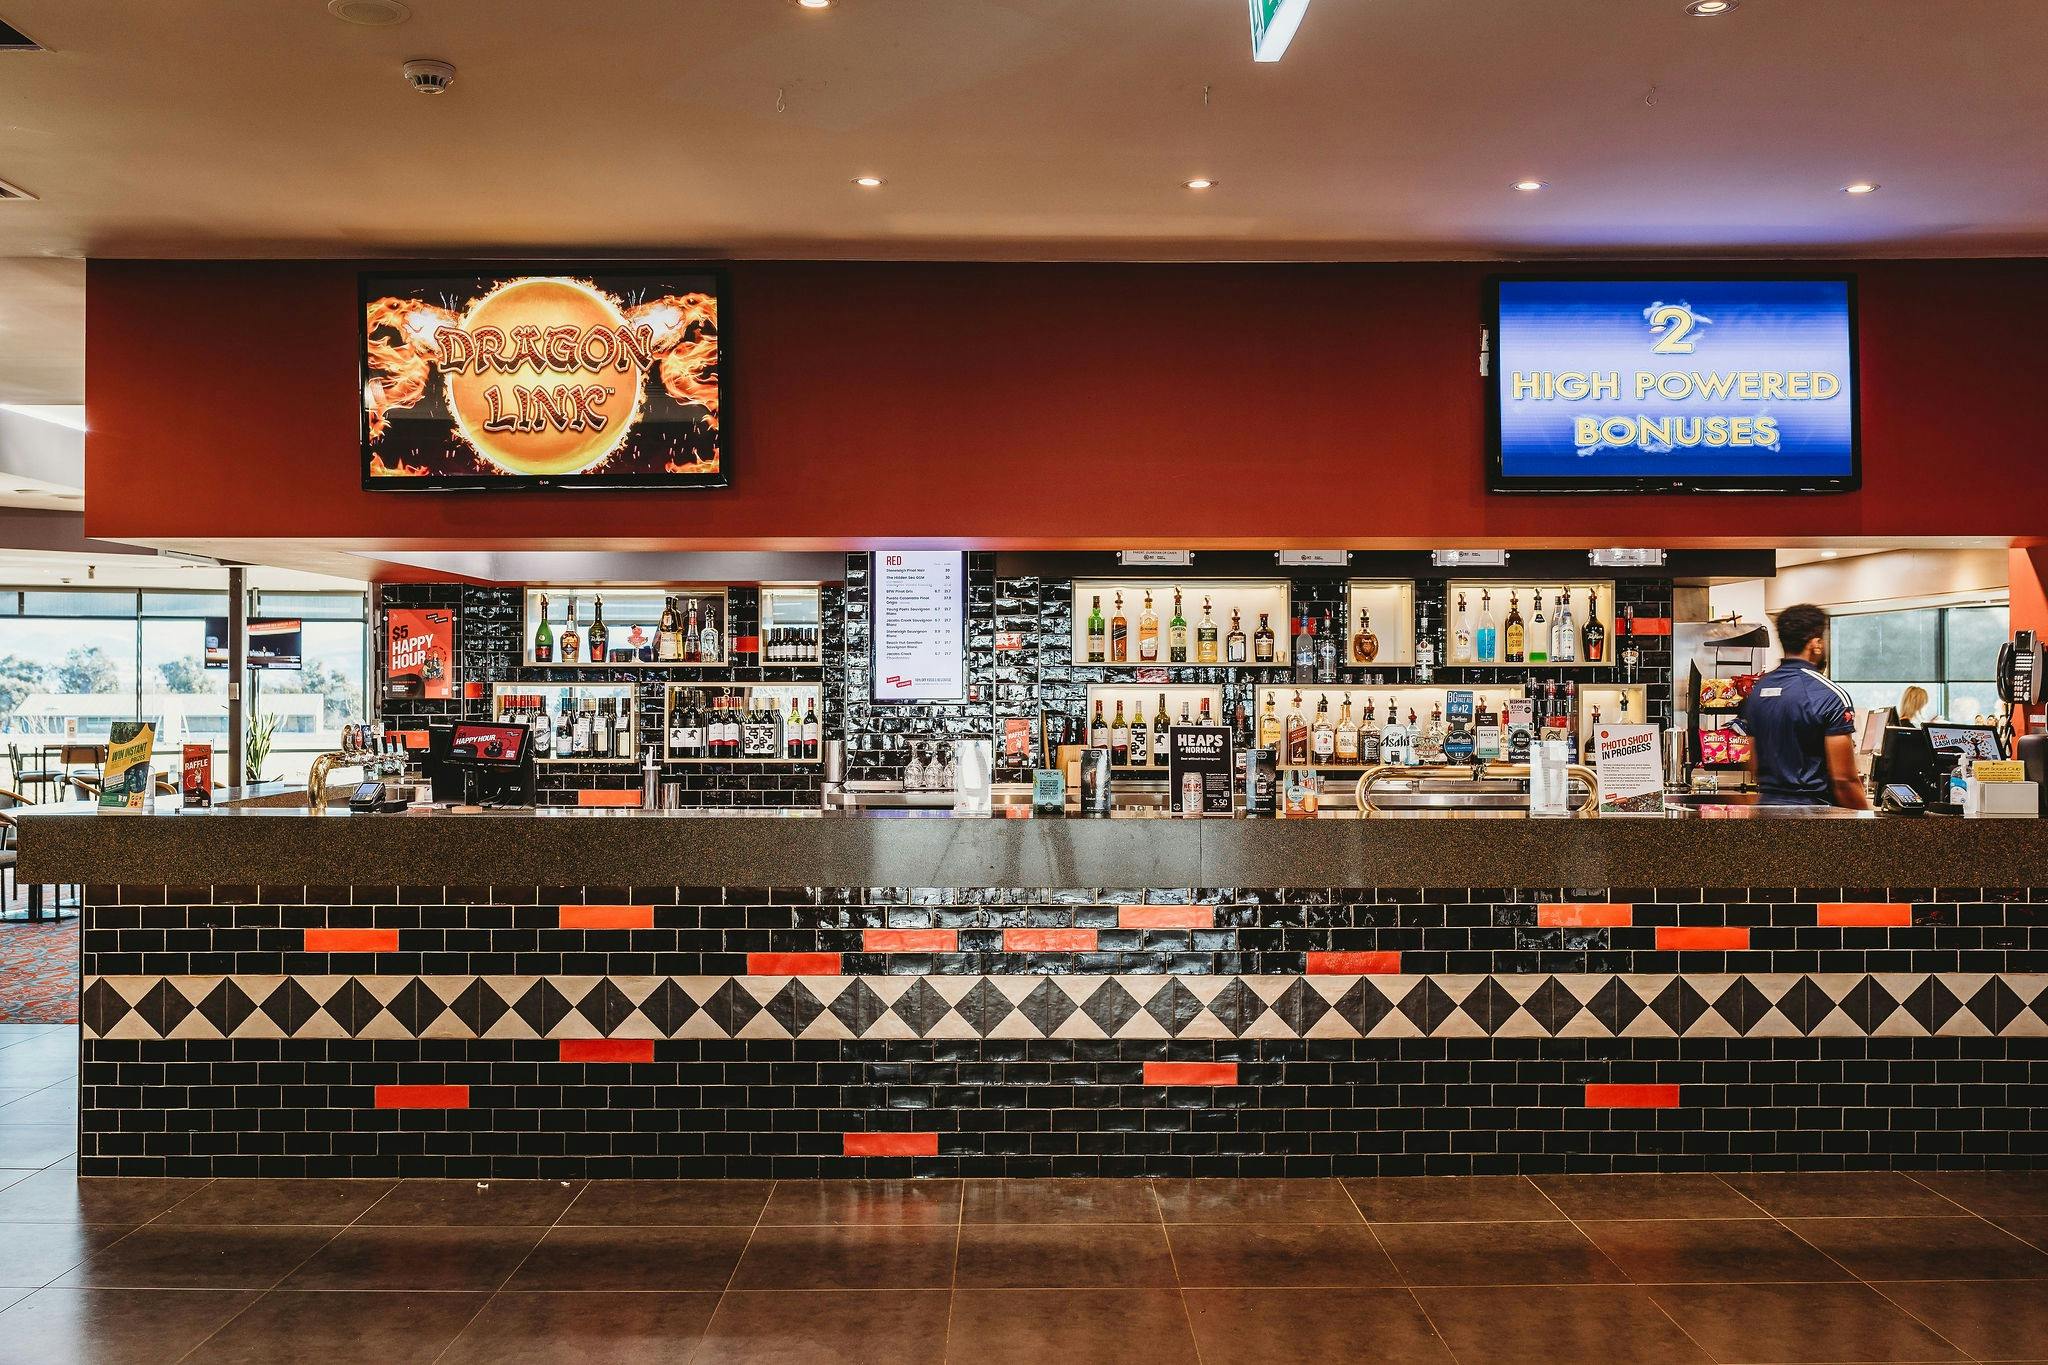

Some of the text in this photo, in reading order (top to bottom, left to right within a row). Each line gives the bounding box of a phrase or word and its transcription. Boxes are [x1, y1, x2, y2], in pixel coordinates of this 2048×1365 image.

[1651, 307, 1695, 353] 2
[434, 324, 656, 374] DRAGON
[1511, 371, 1842, 400] HIGH POWERED
[484, 383, 609, 434] LINK
[1575, 416, 1779, 447] BONUSES
[886, 556, 902, 566] RED
[392, 625, 408, 640] $5
[392, 634, 434, 656] HAPPY
[392, 650, 426, 670] HOUR
[456, 736, 478, 745] HAPPY
[1178, 734, 1223, 746] HEAPS
[1381, 735, 1410, 747] Asahi
[1602, 733, 1653, 751] PHOTO SHOOT
[125, 742, 148, 758] INSTANT
[1602, 743, 1651, 760] IN PROGRESS
[185, 759, 208, 770] RAFFLE
